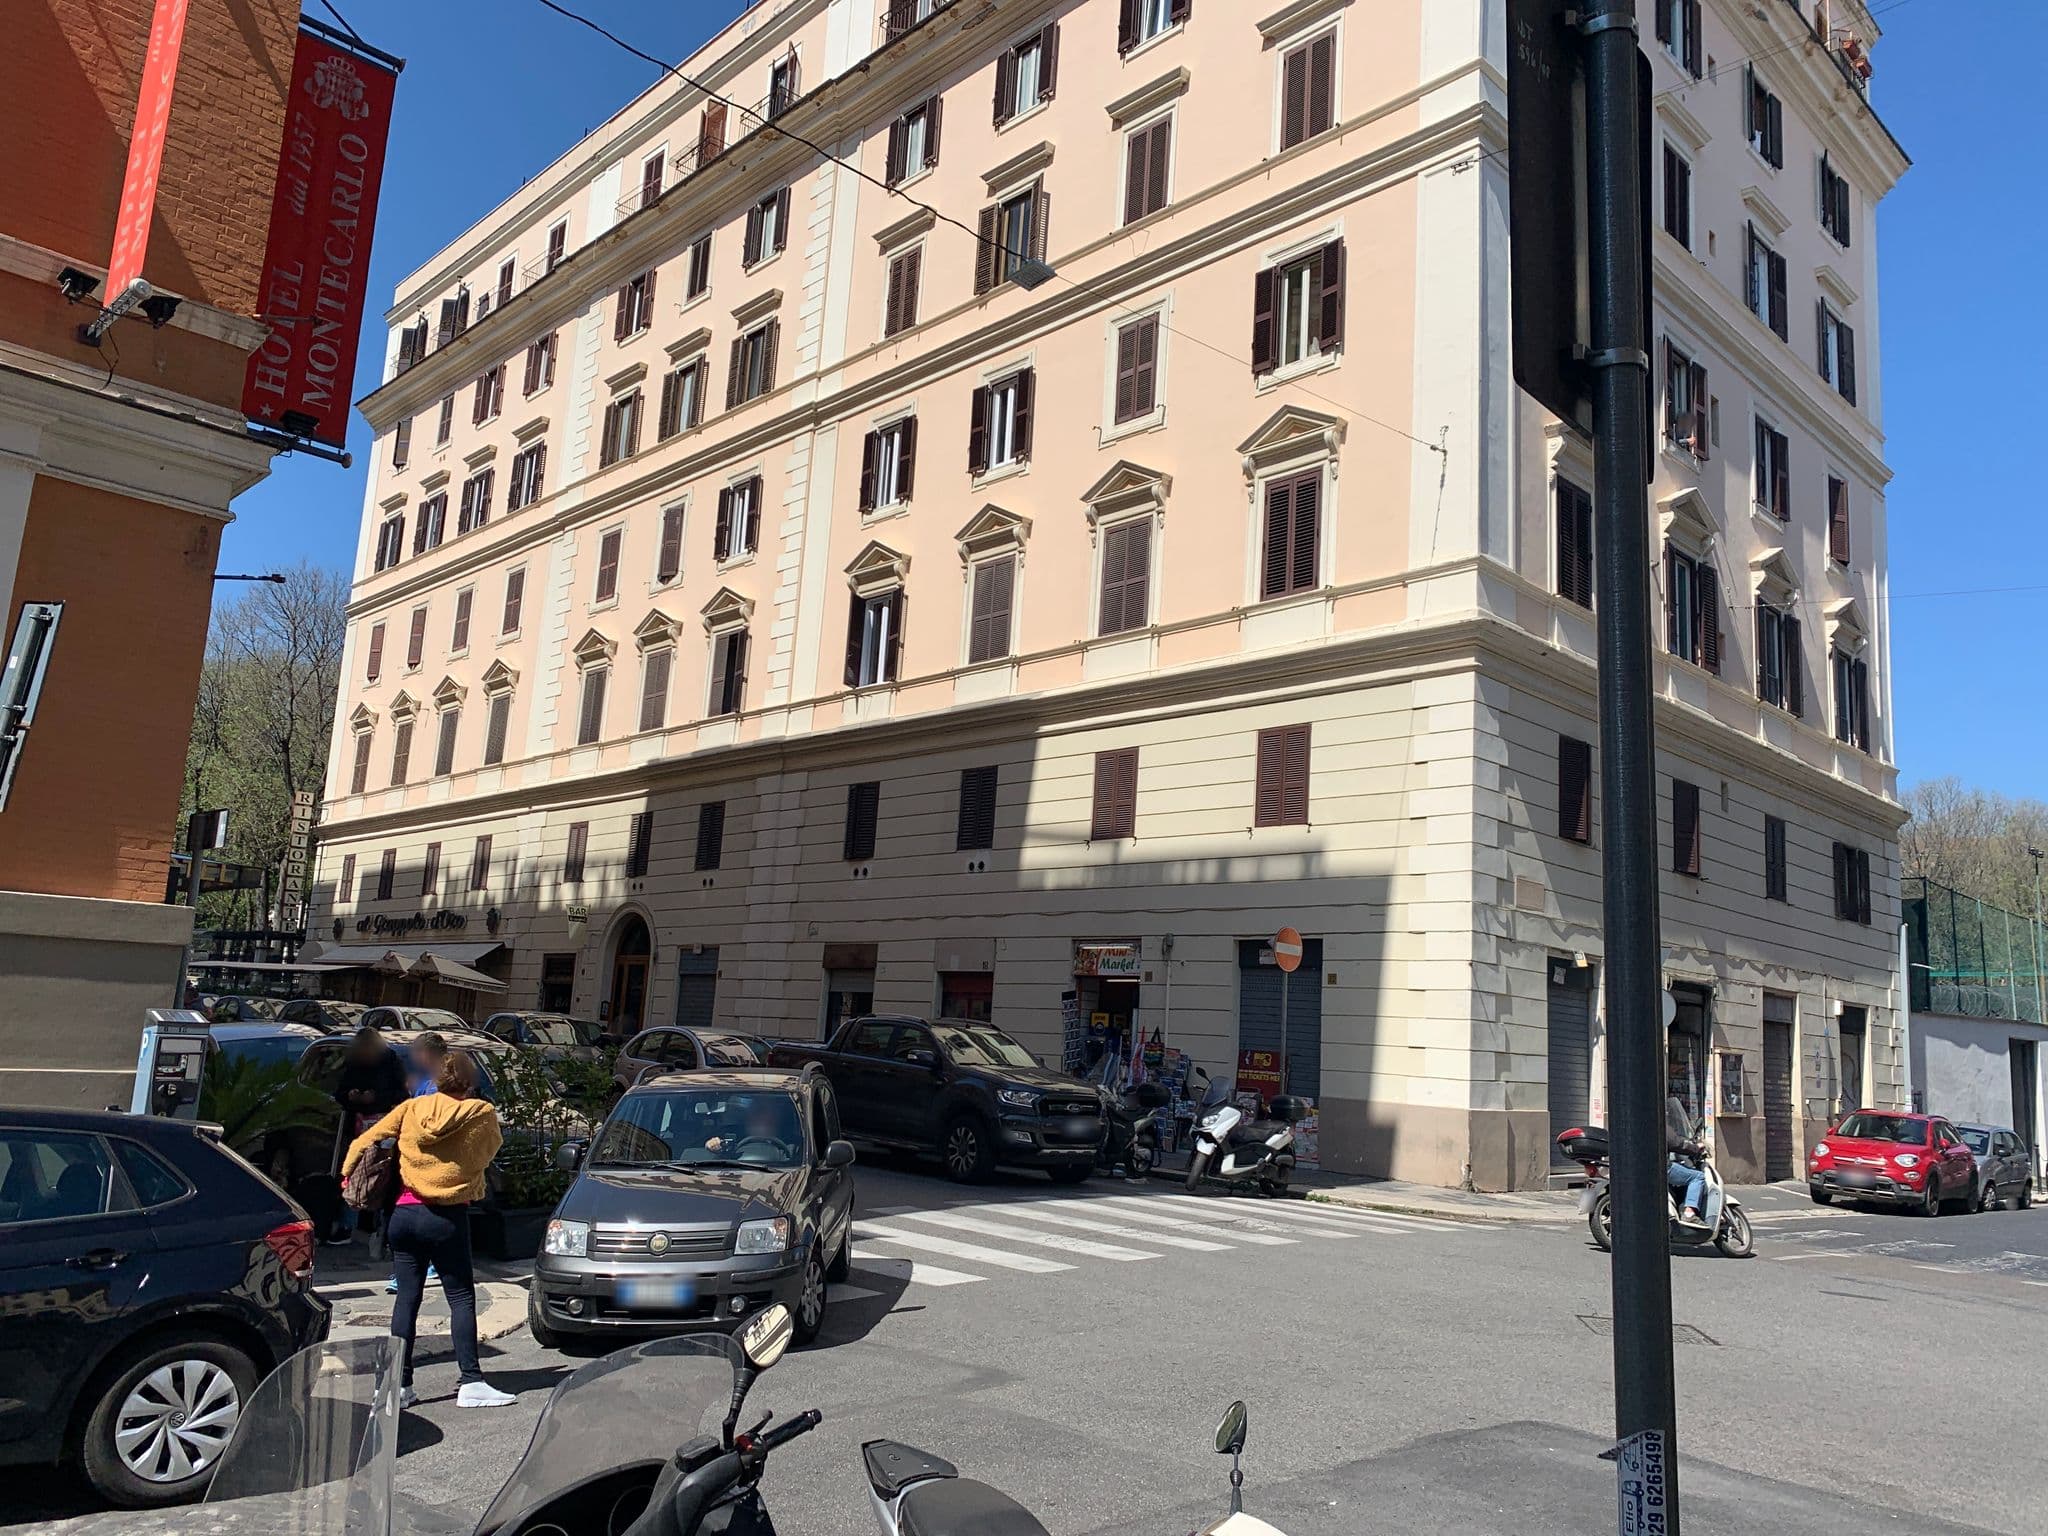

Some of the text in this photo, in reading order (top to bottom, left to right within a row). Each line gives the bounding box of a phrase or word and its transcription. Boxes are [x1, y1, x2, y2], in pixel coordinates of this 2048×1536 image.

[289, 111, 316, 174] 1957
[302, 132, 369, 413] MONTECARLO
[253, 260, 304, 399] HOTEL
[284, 793, 311, 932] RISTORANTE
[569, 907, 587, 917] BAR
[1099, 957, 1136, 973] Market
[1644, 1431, 1665, 1536] 29 6265498
